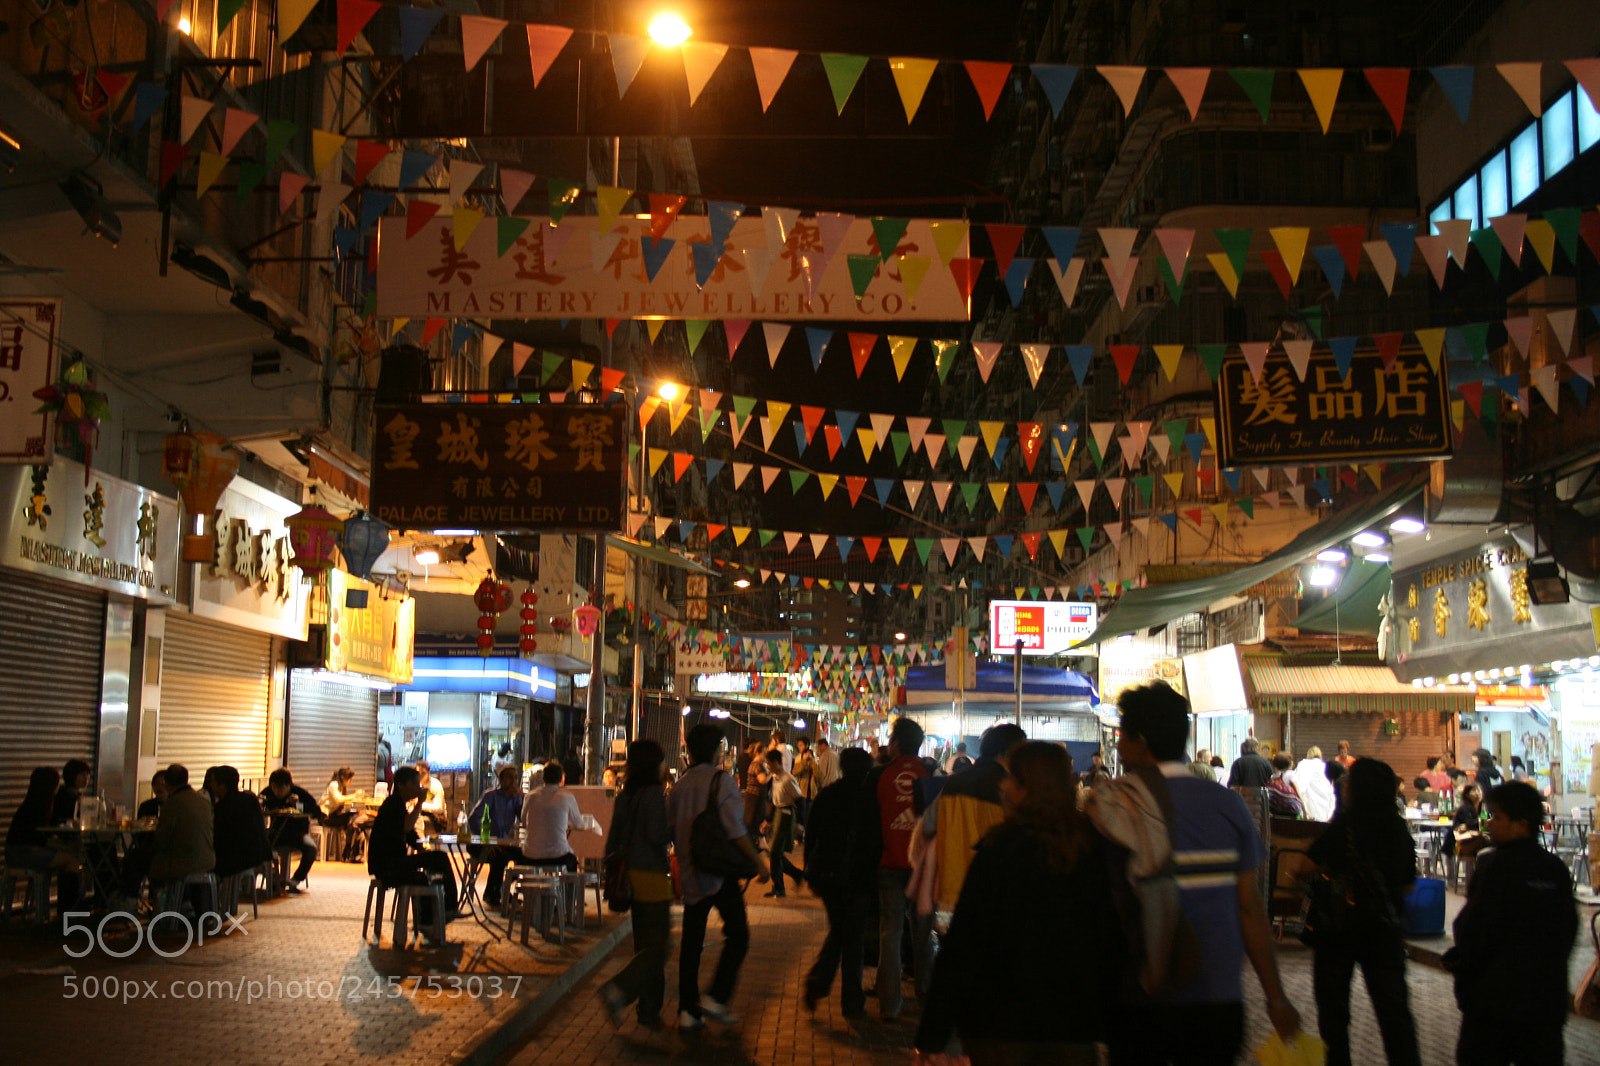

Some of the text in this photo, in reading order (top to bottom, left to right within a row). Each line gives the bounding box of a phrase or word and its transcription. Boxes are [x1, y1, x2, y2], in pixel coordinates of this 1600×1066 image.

[427, 291, 917, 314] MASTERY JEWELLERY CO.
[1237, 361, 1429, 426] 髮品店
[384, 412, 614, 471] 皇城珠寶
[1237, 424, 1438, 453] Supply For Beauty Hair Shop
[452, 476, 542, 499] 有限公司
[379, 506, 614, 522] PALACE JEWELLERY LTD.
[1421, 564, 1457, 589] TEMPLE
[1459, 548, 1494, 579] SPICE
